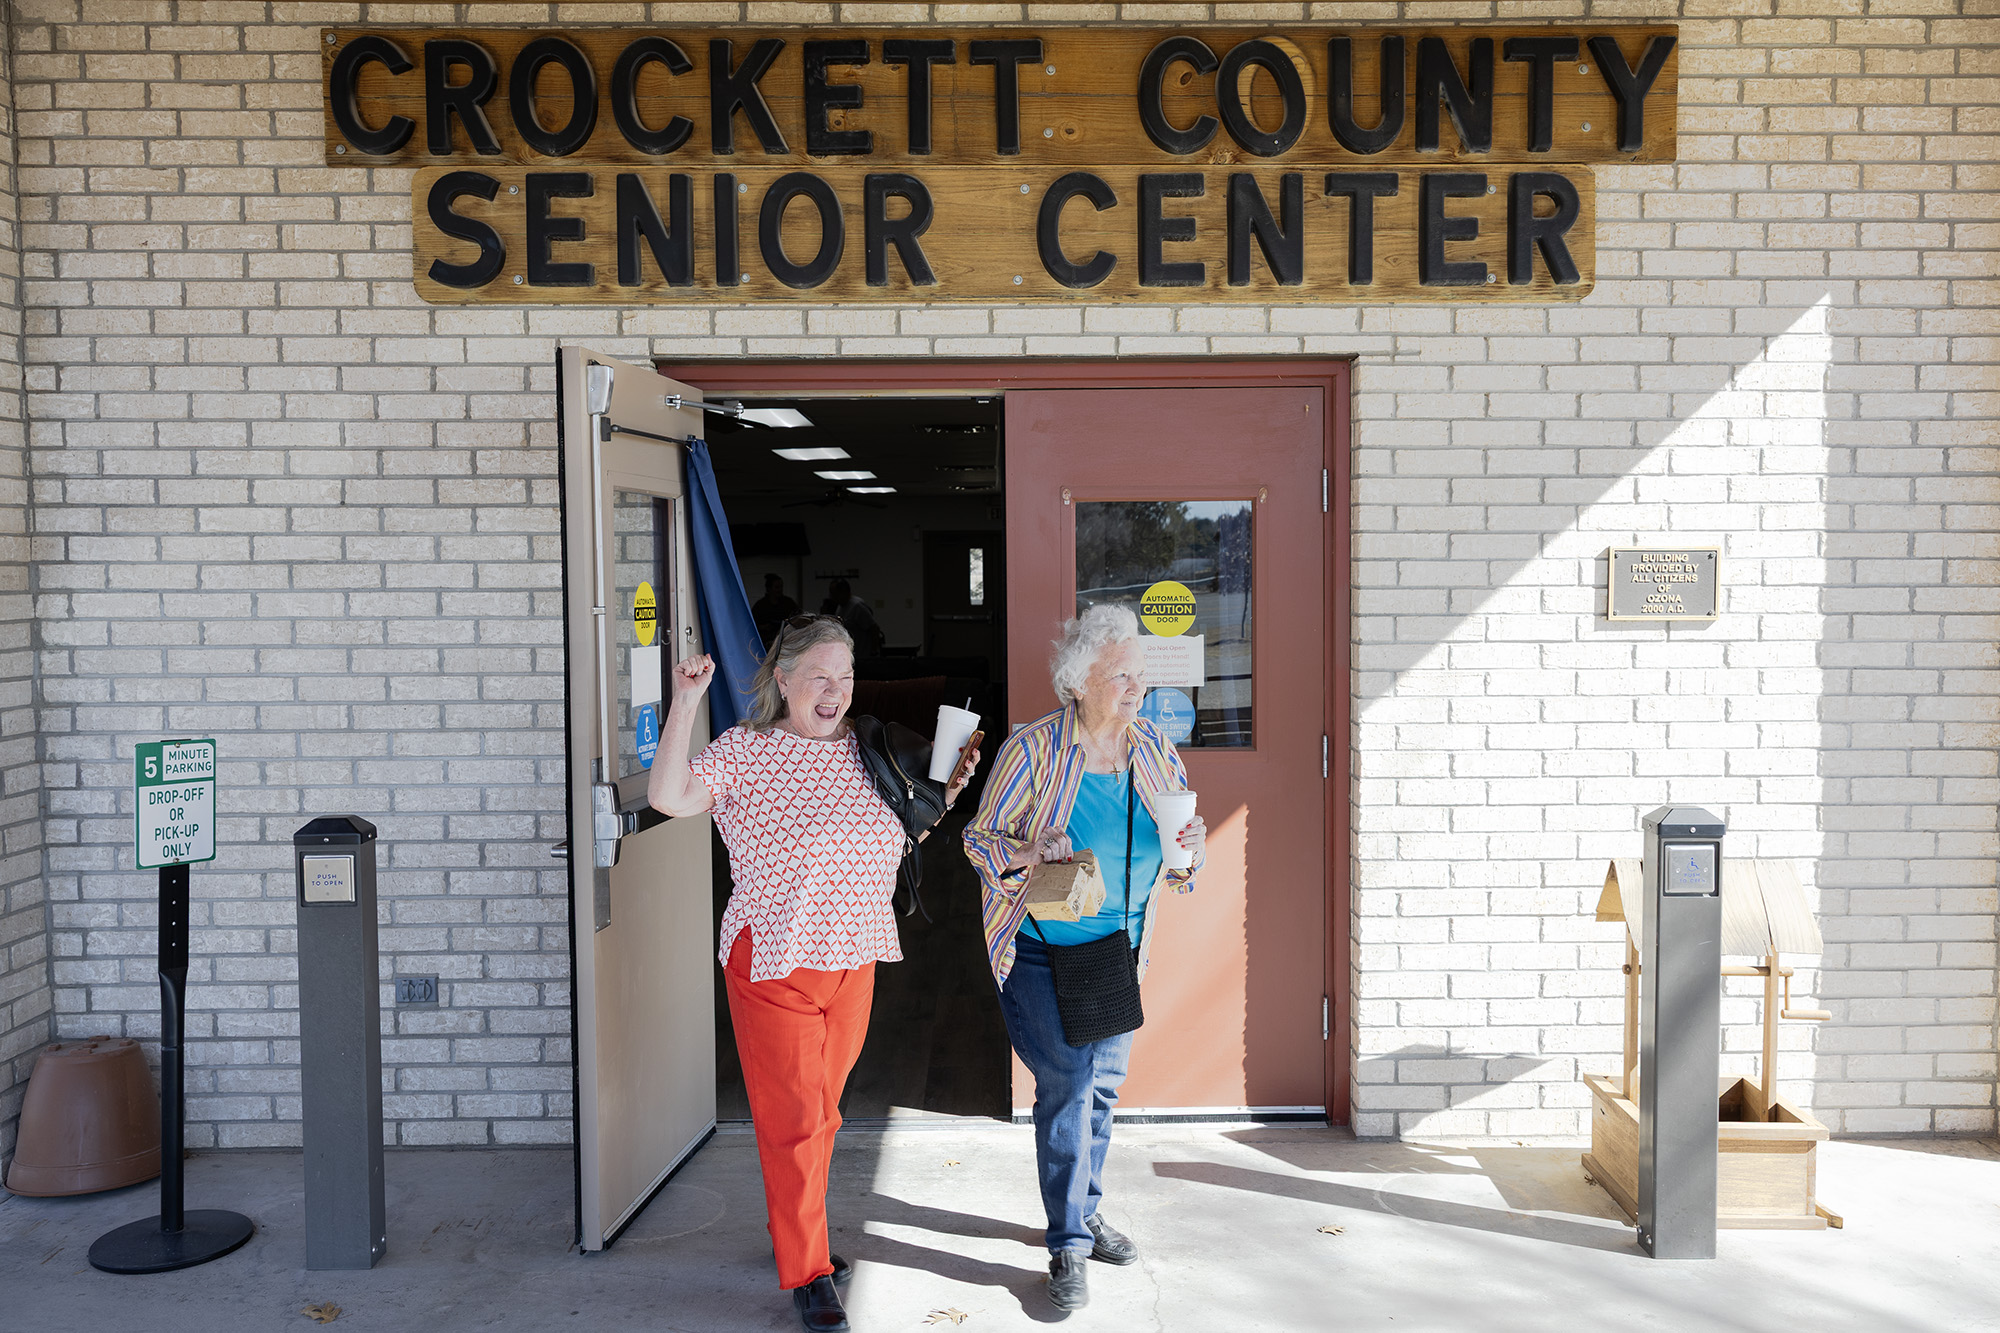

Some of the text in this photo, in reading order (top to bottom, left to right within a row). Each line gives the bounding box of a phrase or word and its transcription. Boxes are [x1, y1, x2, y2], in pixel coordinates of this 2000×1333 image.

[329, 34, 1677, 158] CROCKETT COUNTY
[427, 170, 1581, 289] SENIOR CENTER
[1641, 553, 1689, 563] BUILDING
[1631, 563, 1700, 573] PROVIDED BY
[1631, 573, 1699, 583] ALL CITIZENS
[1657, 583, 1672, 593] OF
[1646, 594, 1682, 604] OZONA
[1143, 604, 1193, 614] CAUTION
[1641, 604, 1687, 614] 2000 A.D.
[168, 748, 209, 761] MINUTE
[144, 756, 158, 779] 5
[165, 761, 212, 775] PARKING
[149, 787, 205, 805] DROP-OFF
[169, 807, 185, 821] OR
[154, 823, 200, 842] PICK-UP
[162, 842, 192, 858] ONLY
